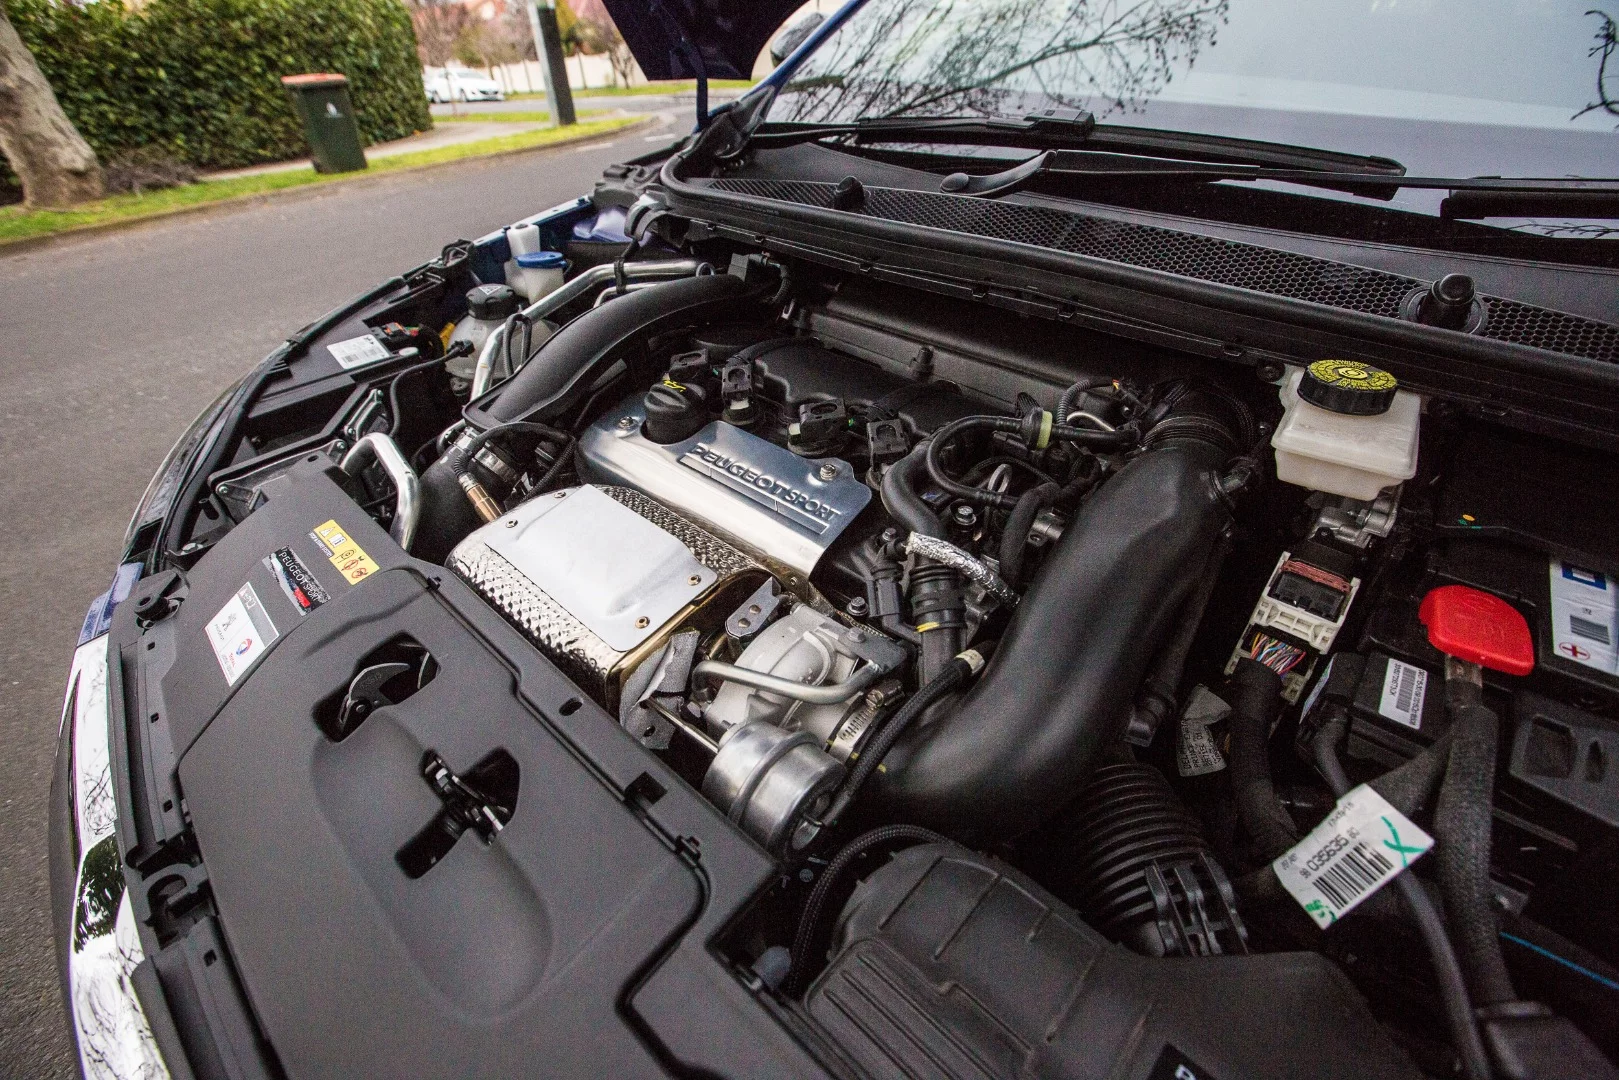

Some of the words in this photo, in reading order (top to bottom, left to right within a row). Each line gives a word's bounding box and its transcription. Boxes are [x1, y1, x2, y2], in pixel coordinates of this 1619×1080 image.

[691, 443, 790, 496] PEUGEOT
[786, 489, 842, 521] SPORT
[279, 552, 308, 587] PEUGEOT
